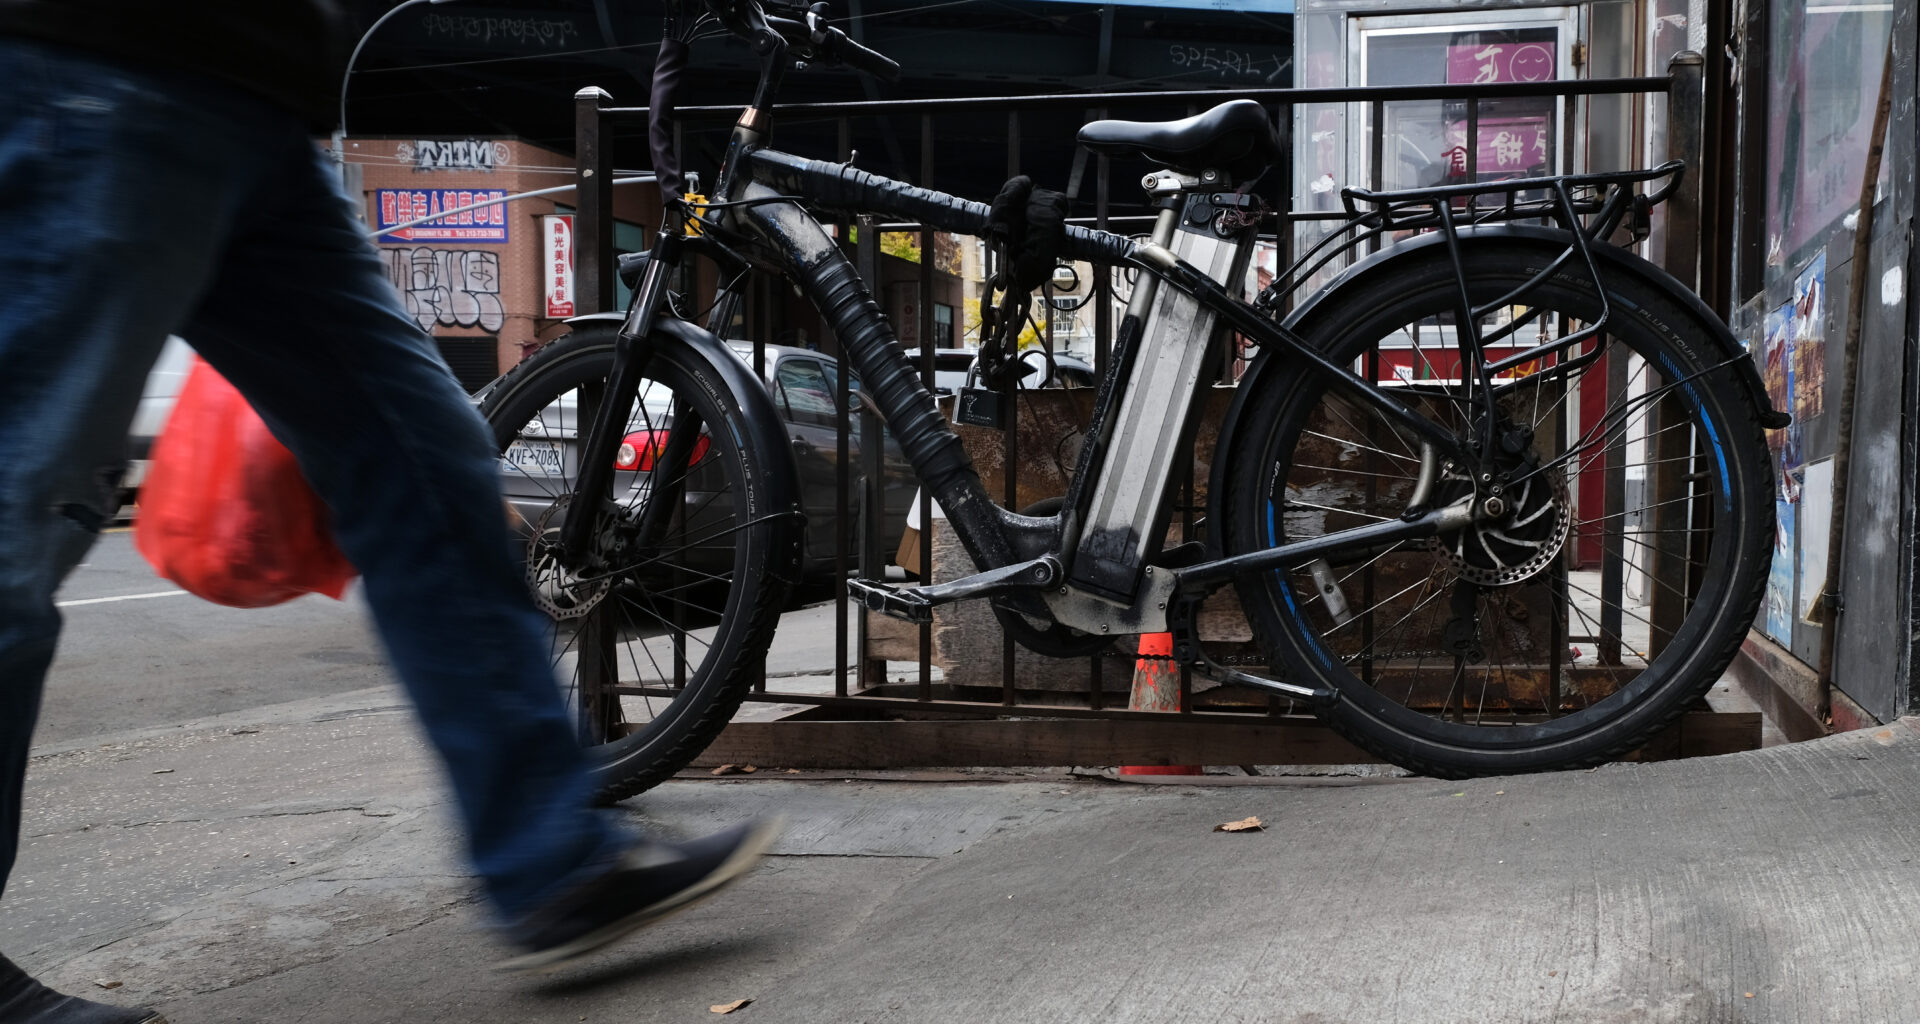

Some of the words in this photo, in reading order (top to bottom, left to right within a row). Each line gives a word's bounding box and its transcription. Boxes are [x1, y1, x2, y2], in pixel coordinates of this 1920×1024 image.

[1638, 309, 1670, 332] PLUS
[1671, 333, 1697, 360] TOUR
[693, 369, 727, 412] SCHWALBE
[740, 449, 752, 480] PLUS
[748, 483, 756, 515] TOUR
